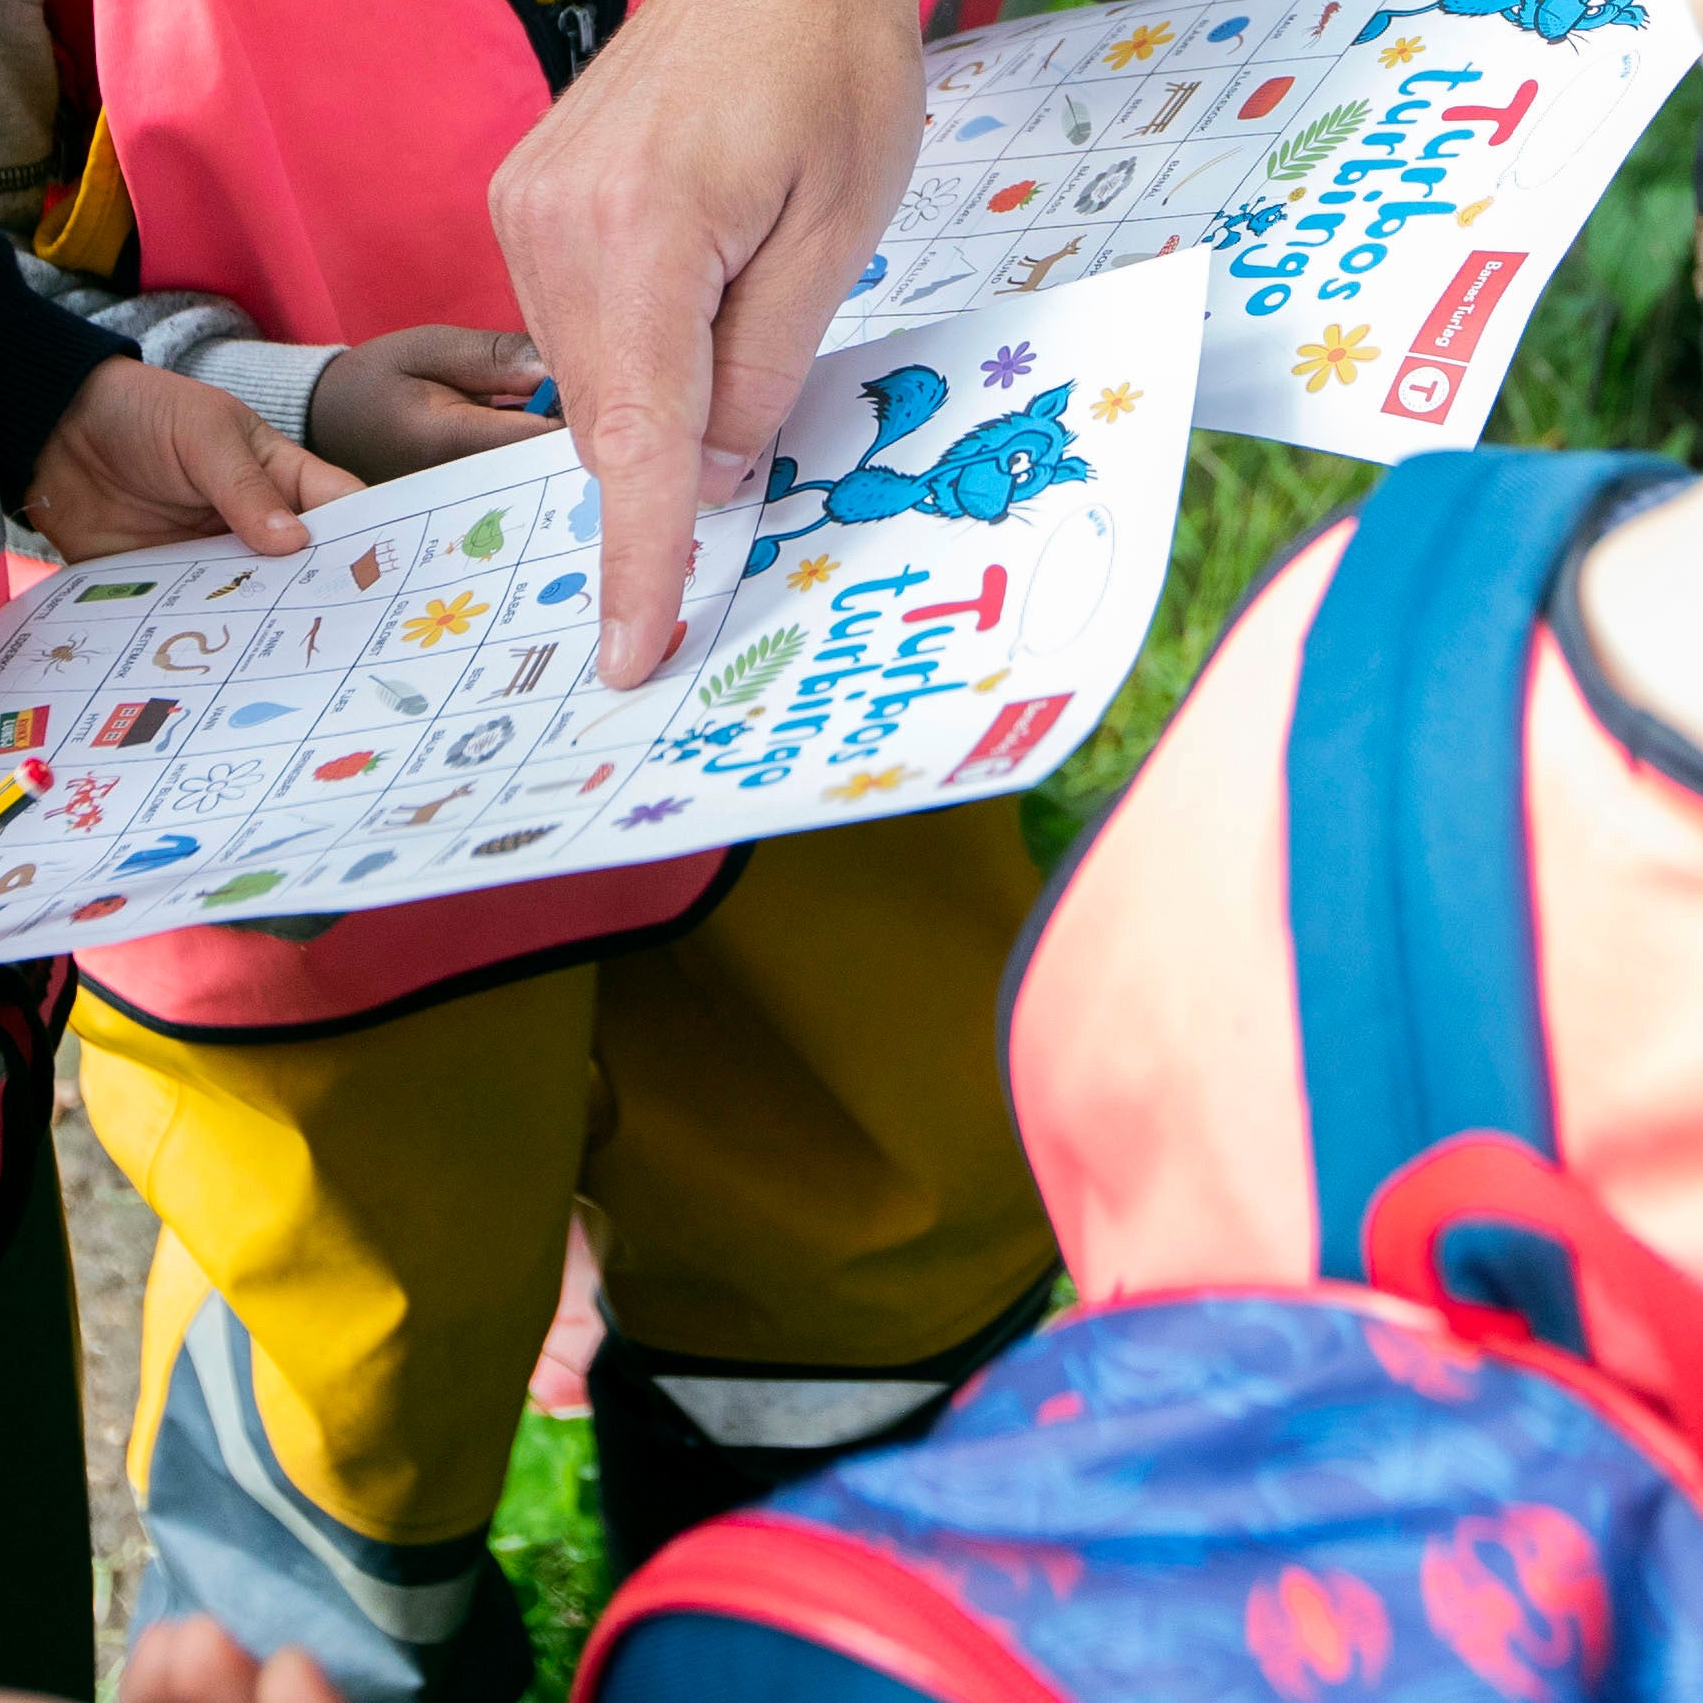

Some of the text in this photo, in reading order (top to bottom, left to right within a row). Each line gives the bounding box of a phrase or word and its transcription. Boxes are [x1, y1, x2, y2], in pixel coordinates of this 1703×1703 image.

[1273, 14, 1297, 39] MAUR
[1117, 99, 1142, 124] BENK
[1198, 71, 1250, 131] FLASKEKORK
[1230, 62, 1482, 316] turbingo
[1318, 80, 1538, 301] Turbos
[891, 252, 936, 302] FJELLTOPP
[991, 256, 1018, 284] HUND
[1089, 250, 1113, 276] SOPP
[1435, 260, 1503, 348] Barnas Turlag
[1409, 381, 1438, 402] T
[541, 510, 556, 529] SKY
[419, 539, 439, 567] FUGL
[185, 567, 207, 583] VEPS
[299, 569, 319, 584] BRO
[501, 583, 527, 625] BLÅBÆR
[370, 601, 409, 656] GUL BLOMST
[116, 627, 156, 678] MEITEMARK
[258, 631, 284, 657] PINNE
[702, 564, 929, 788] turbingo
[828, 564, 1008, 764] Turbos
[71, 713, 99, 742] HYTTE
[203, 706, 226, 730] VANN
[141, 764, 187, 823] HVIT BLOMST
